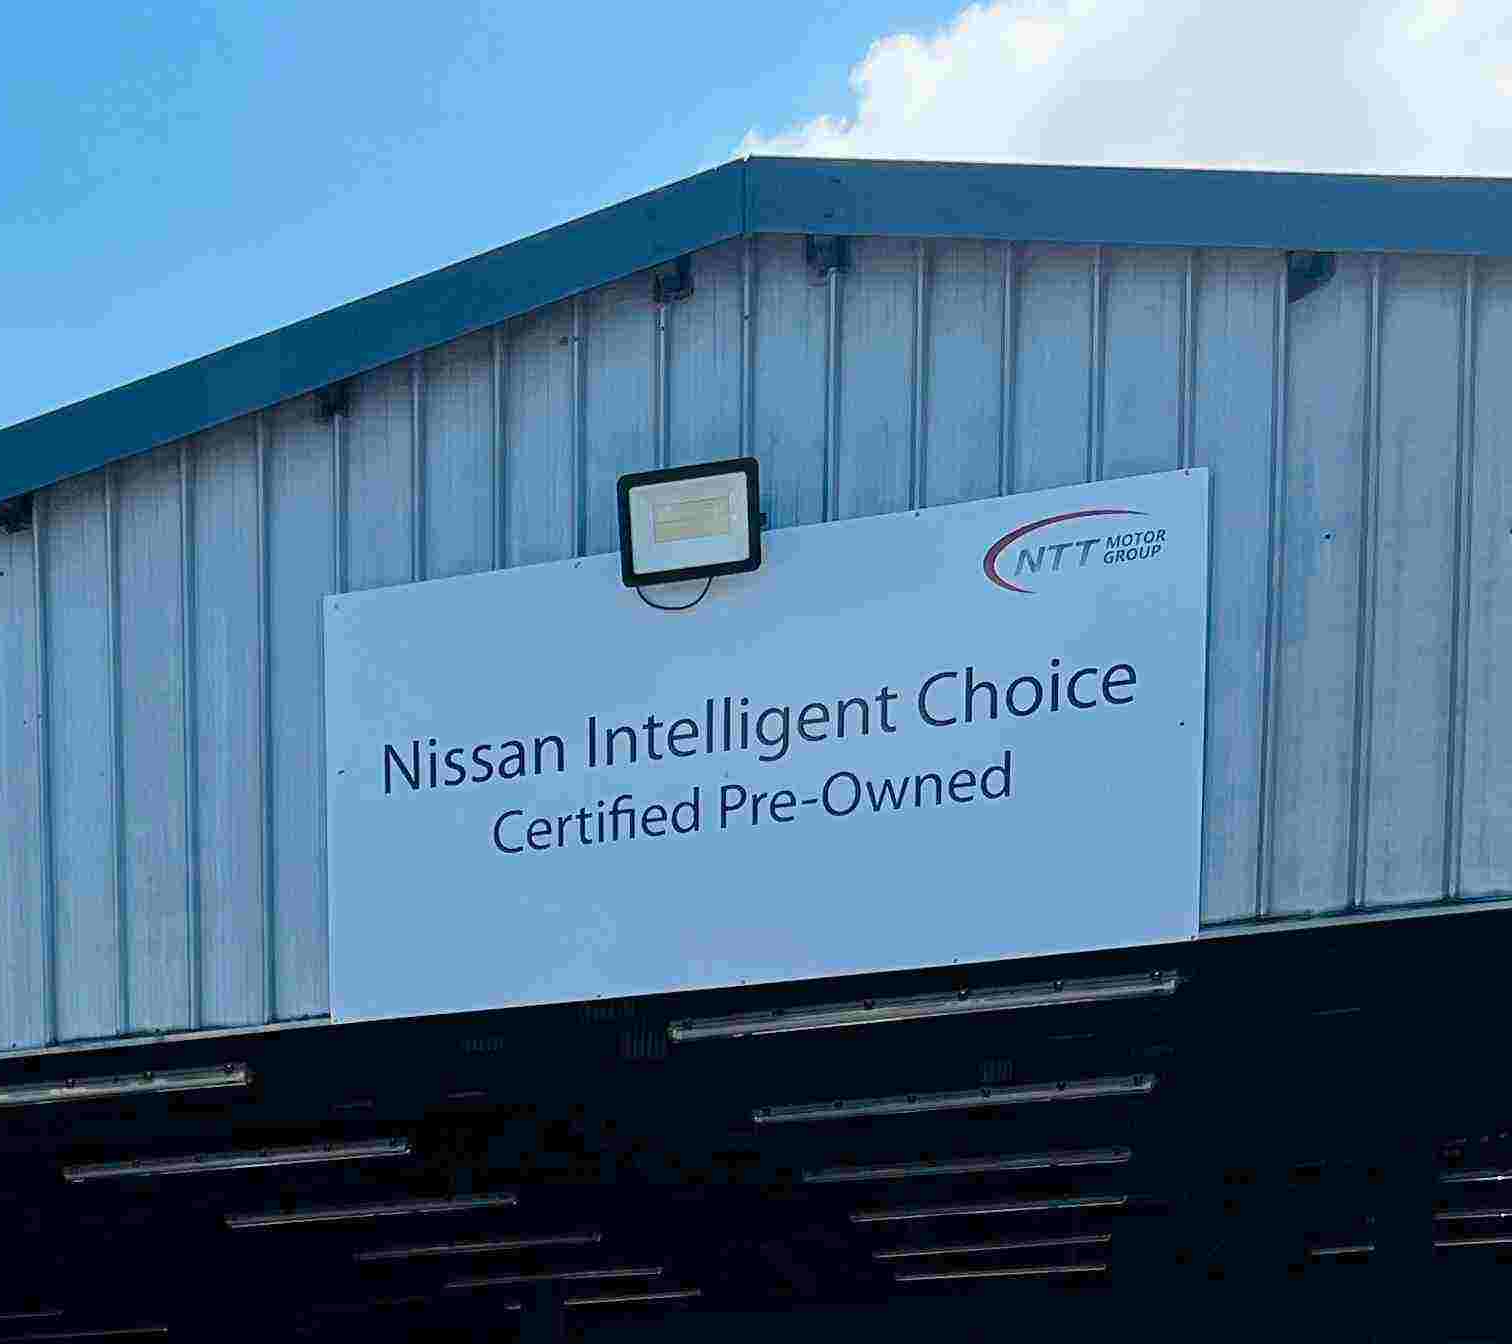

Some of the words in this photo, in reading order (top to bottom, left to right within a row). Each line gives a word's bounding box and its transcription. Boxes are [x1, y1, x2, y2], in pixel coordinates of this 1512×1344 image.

[1015, 538, 1101, 576] NTT
[1103, 543, 1161, 565] GROUP
[1106, 529, 1166, 550] MOTOR
[384, 735, 565, 795] Nissan
[587, 686, 898, 768] Intelligent
[917, 658, 1138, 727] Choice
[493, 786, 700, 854] Certified
[720, 750, 1011, 829] Pre-Owned
